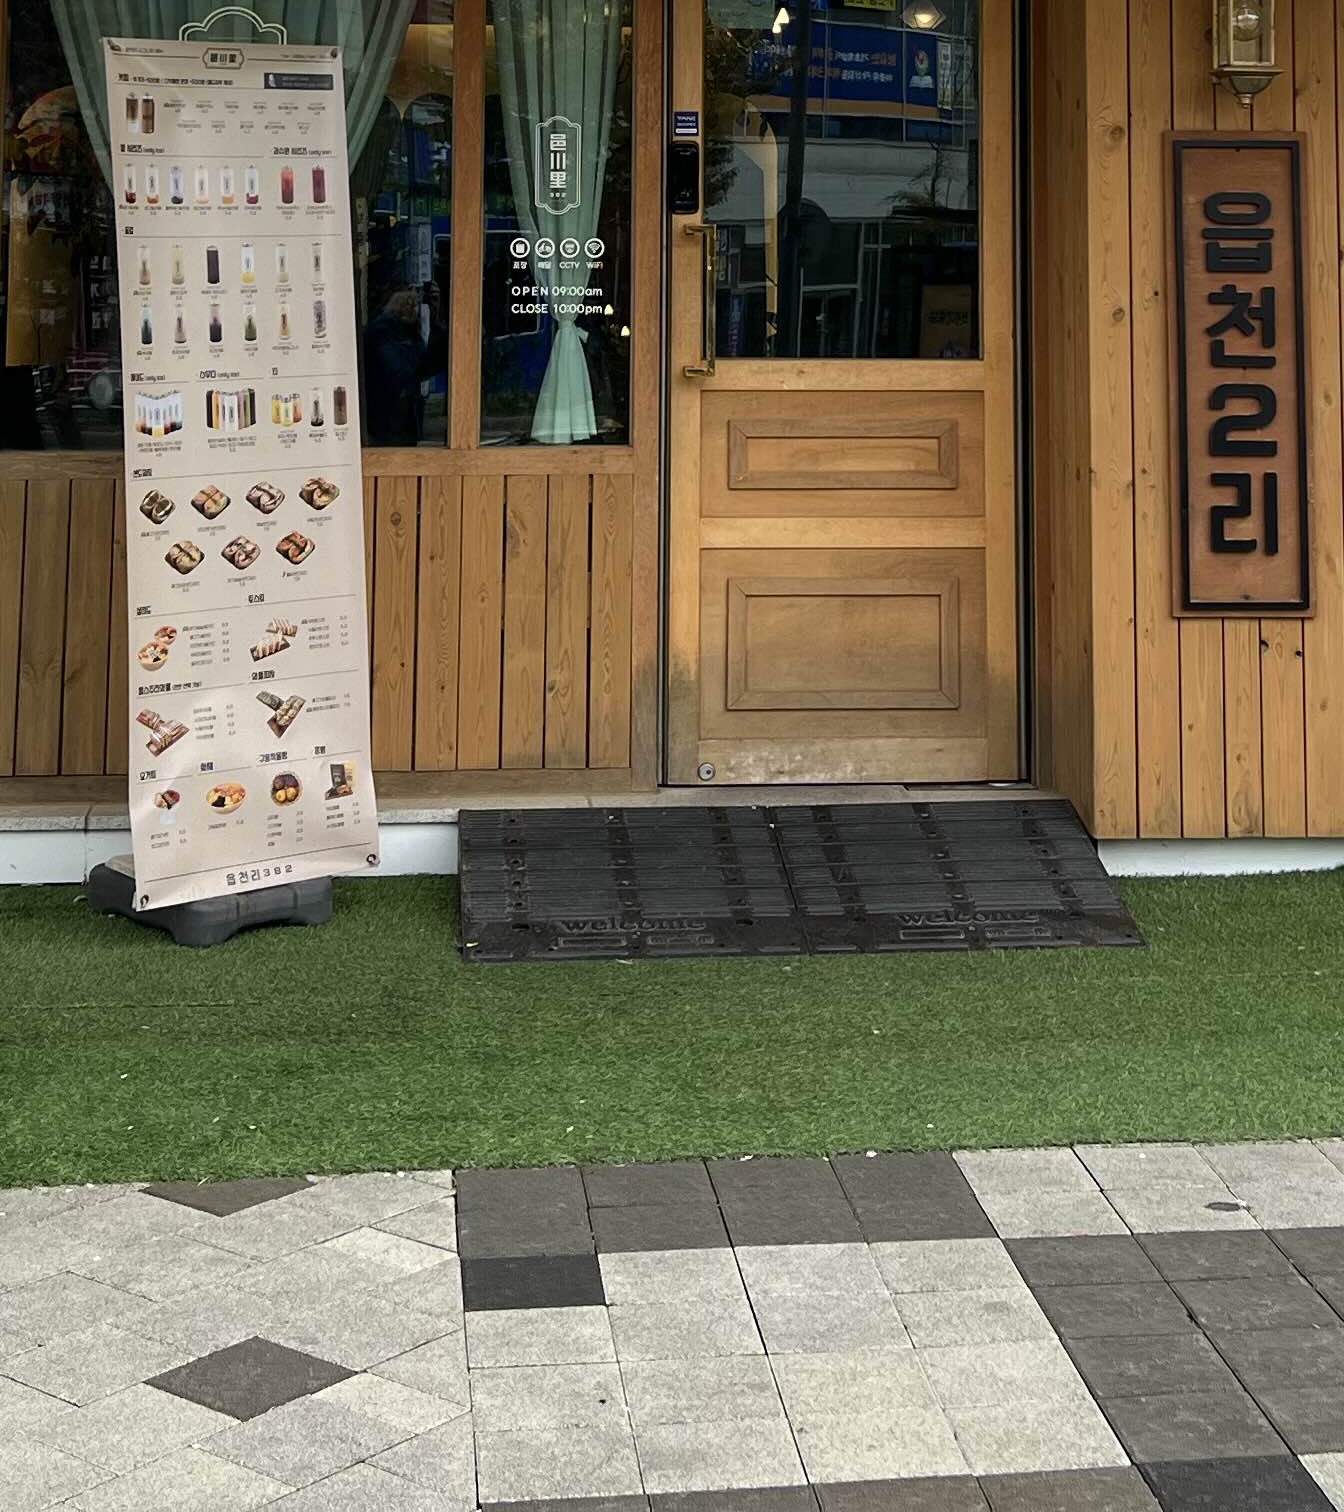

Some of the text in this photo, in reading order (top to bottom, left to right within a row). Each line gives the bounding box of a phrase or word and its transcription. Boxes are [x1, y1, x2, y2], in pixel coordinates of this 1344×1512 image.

[559, 261, 581, 270] CCTV
[511, 286, 603, 297] OPEN 09:00am
[511, 303, 603, 316] CLOSE 10:00pm
[1201, 191, 1279, 556] 읍천2리
